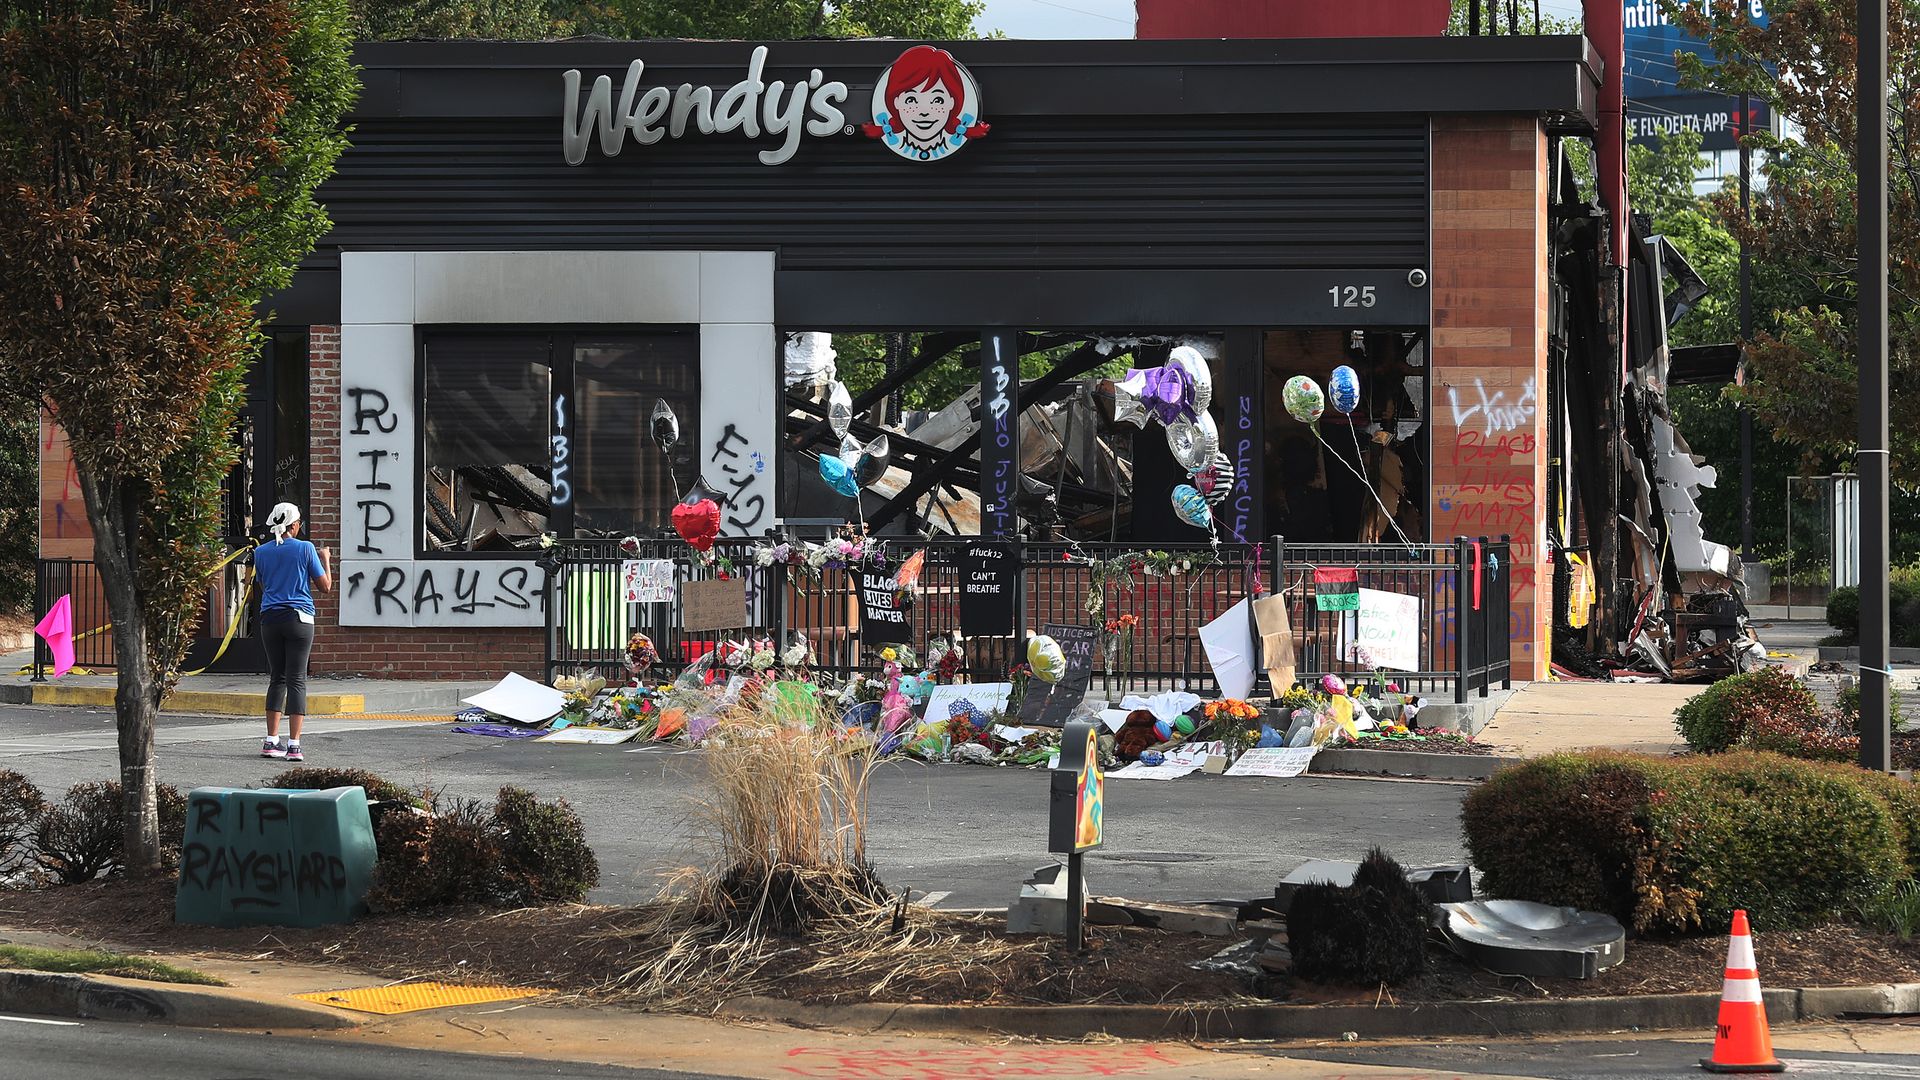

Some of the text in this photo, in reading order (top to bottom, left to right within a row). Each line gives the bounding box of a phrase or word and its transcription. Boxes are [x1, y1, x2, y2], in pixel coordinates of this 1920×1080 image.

[562, 45, 848, 166] Wendy's
[1641, 117, 1660, 137] FLY
[1664, 112, 1700, 134] DELTA
[1703, 112, 1728, 132] APP
[1328, 285, 1376, 308] 125
[347, 387, 397, 554] RIP
[971, 571, 997, 581] CAN'T
[966, 584, 1001, 593] BREATHE
[865, 590, 892, 608] LIVES
[1321, 595, 1358, 608] BROOKS
[867, 607, 904, 623] MATTER
[1046, 627, 1083, 639] JUSTICE
[191, 798, 289, 836] RIP
[180, 841, 347, 897] RAYSHARD
